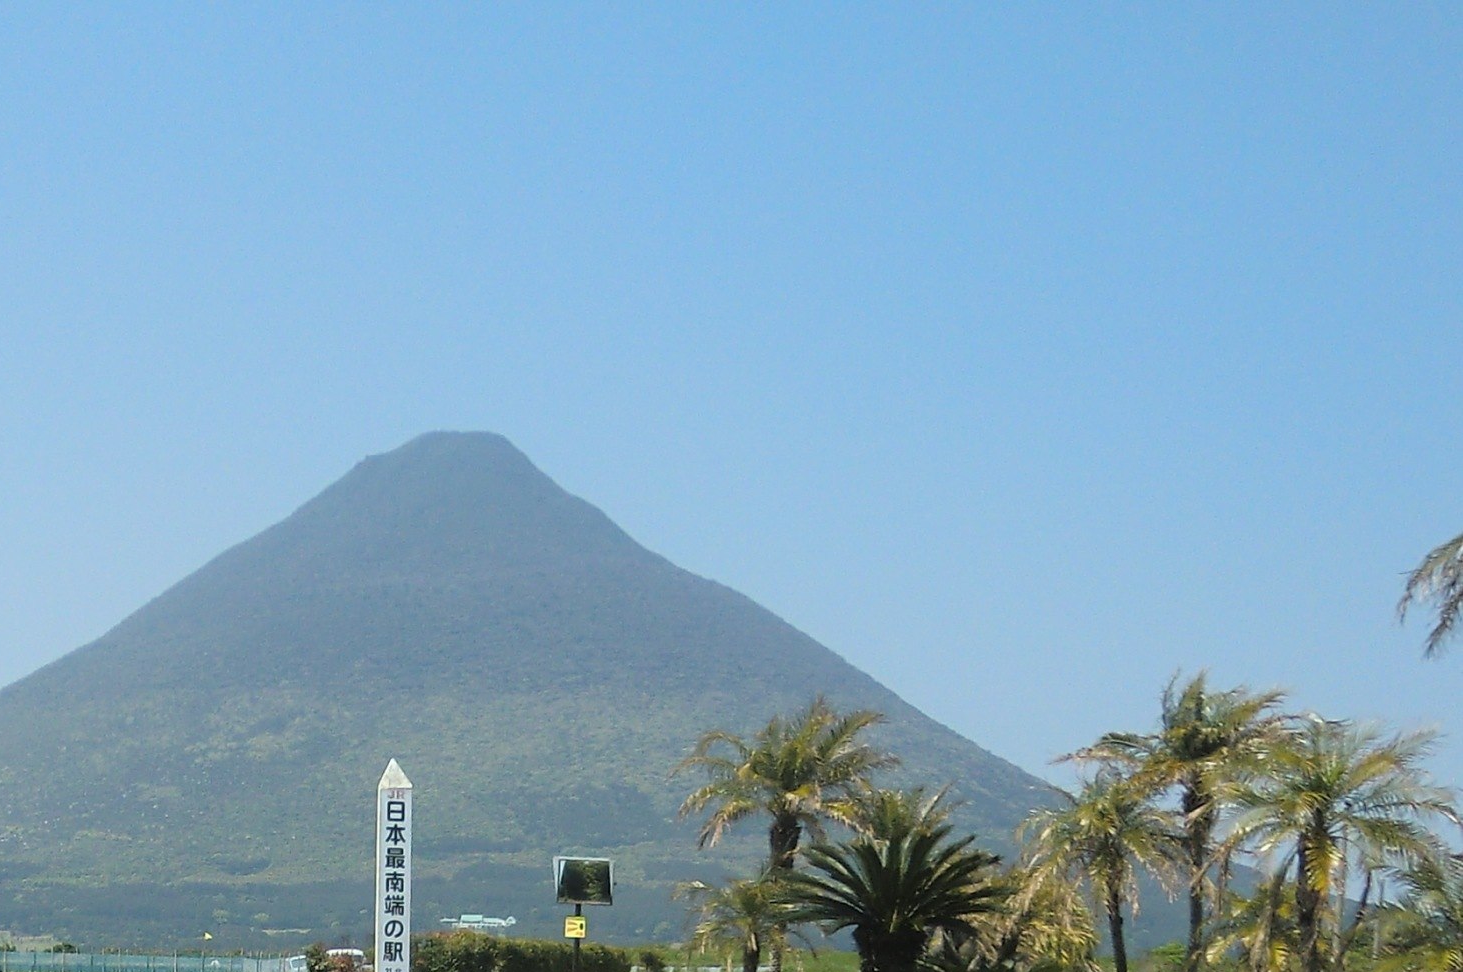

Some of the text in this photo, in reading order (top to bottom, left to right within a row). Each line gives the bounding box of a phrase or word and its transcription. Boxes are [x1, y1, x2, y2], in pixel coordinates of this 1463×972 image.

[383, 801, 406, 962] 日本最南端の駅
